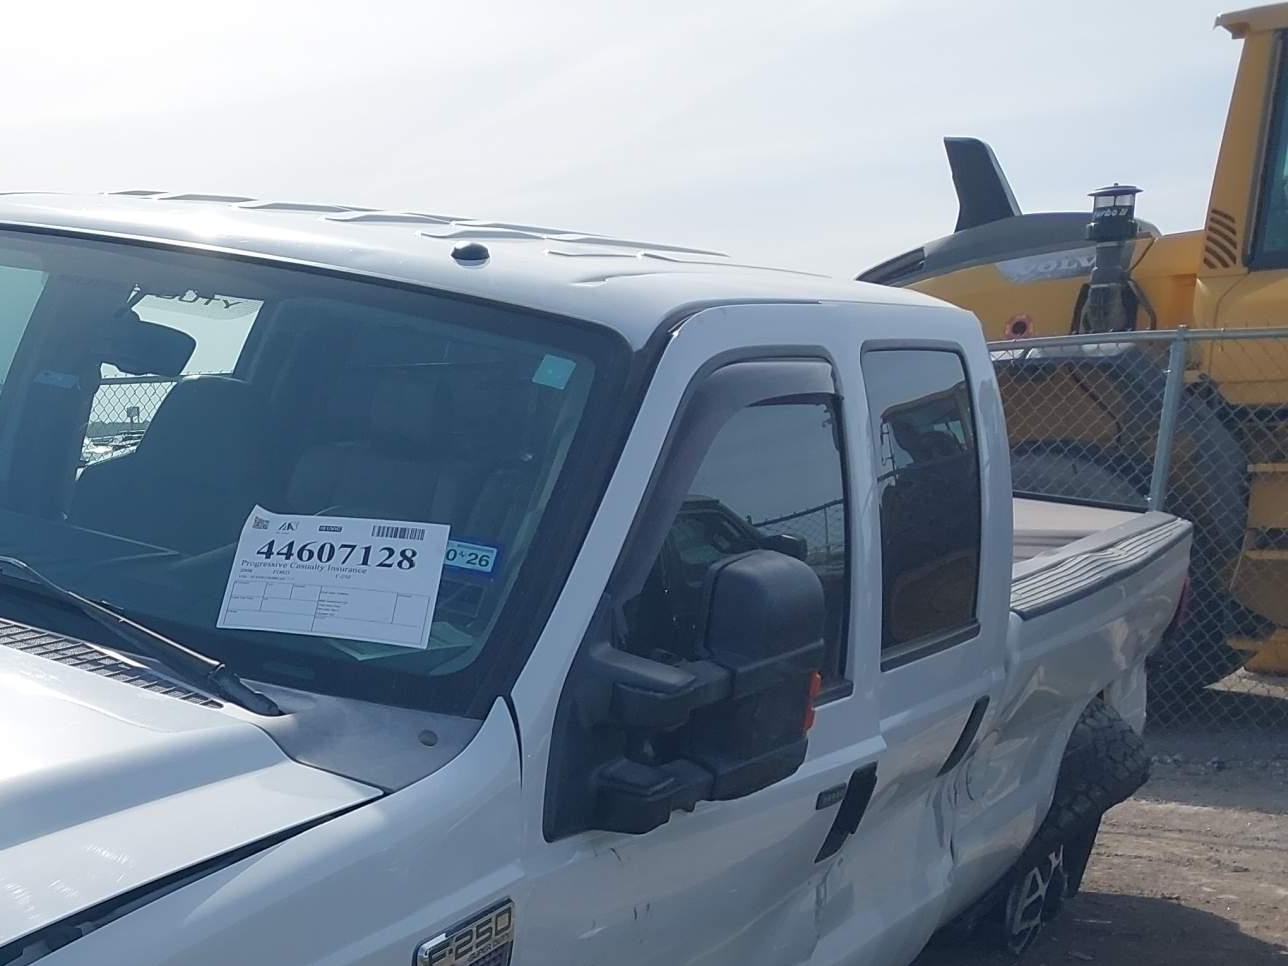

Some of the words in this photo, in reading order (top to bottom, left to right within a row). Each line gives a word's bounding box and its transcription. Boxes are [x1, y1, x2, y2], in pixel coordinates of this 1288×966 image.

[256, 539, 418, 571] 44607128
[466, 551, 491, 568] 26
[241, 559, 288, 569] Progressive
[289, 562, 325, 573] Casualty
[327, 564, 368, 575] Insurance
